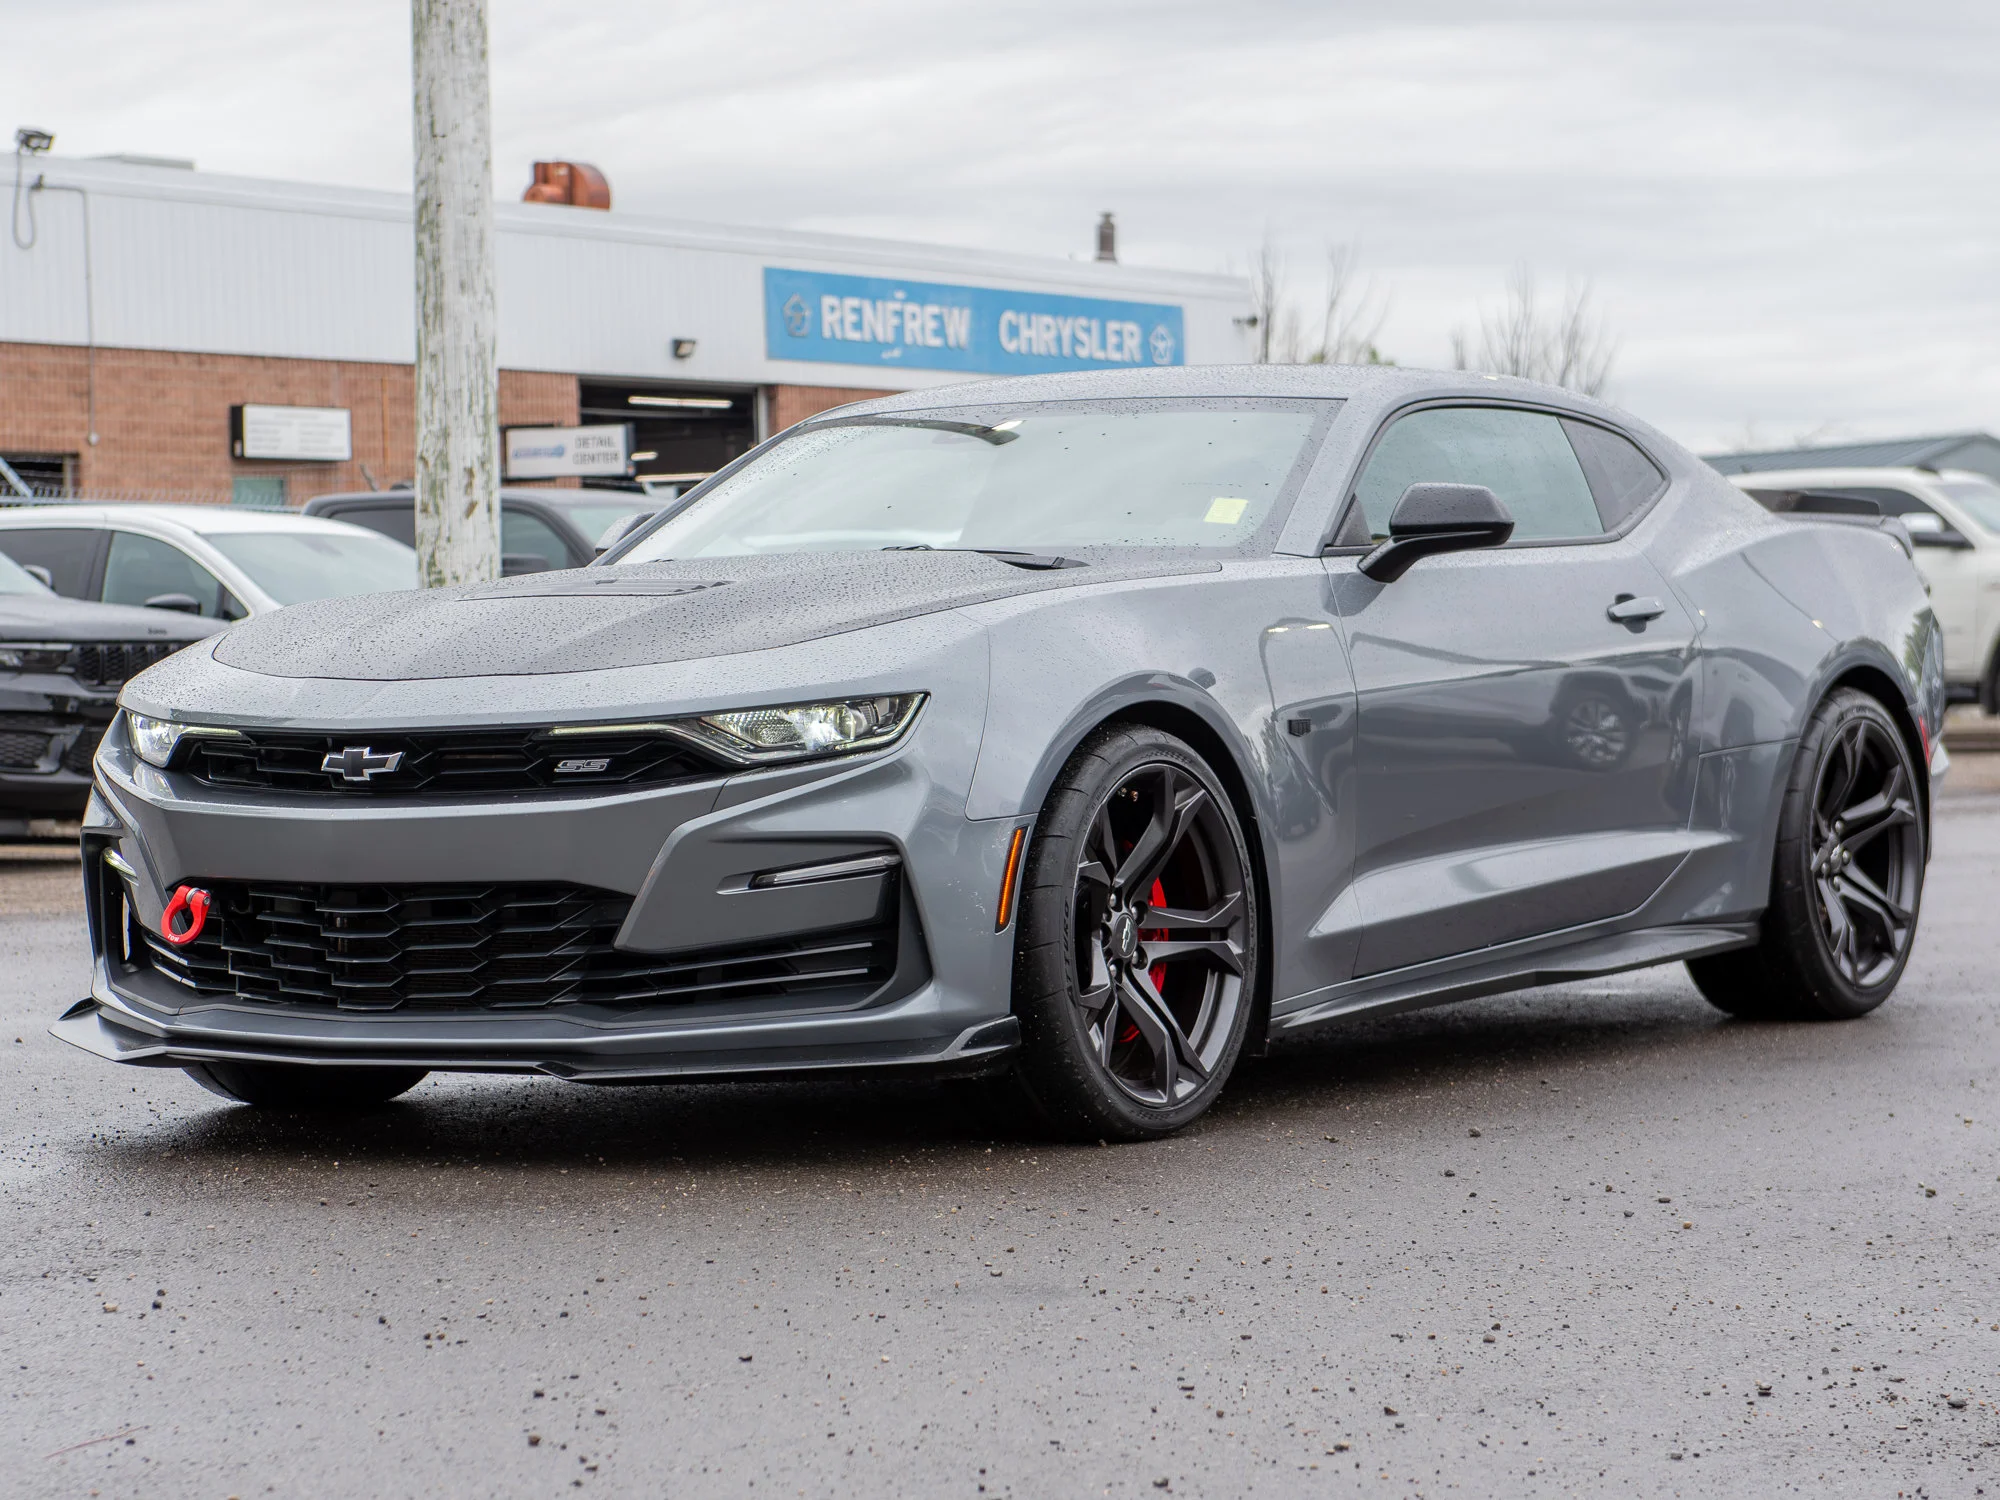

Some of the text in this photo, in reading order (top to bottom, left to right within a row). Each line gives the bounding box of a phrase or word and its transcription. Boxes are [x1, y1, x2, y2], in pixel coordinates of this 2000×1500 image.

[820, 295, 1142, 364] RENFREW CHRYSLER
[575, 435, 616, 449] DETAIL
[572, 451, 619, 465] CENTER
[554, 758, 610, 772] SS
[168, 934, 180, 942] TOW
[1063, 897, 1077, 1009] ATTURO
